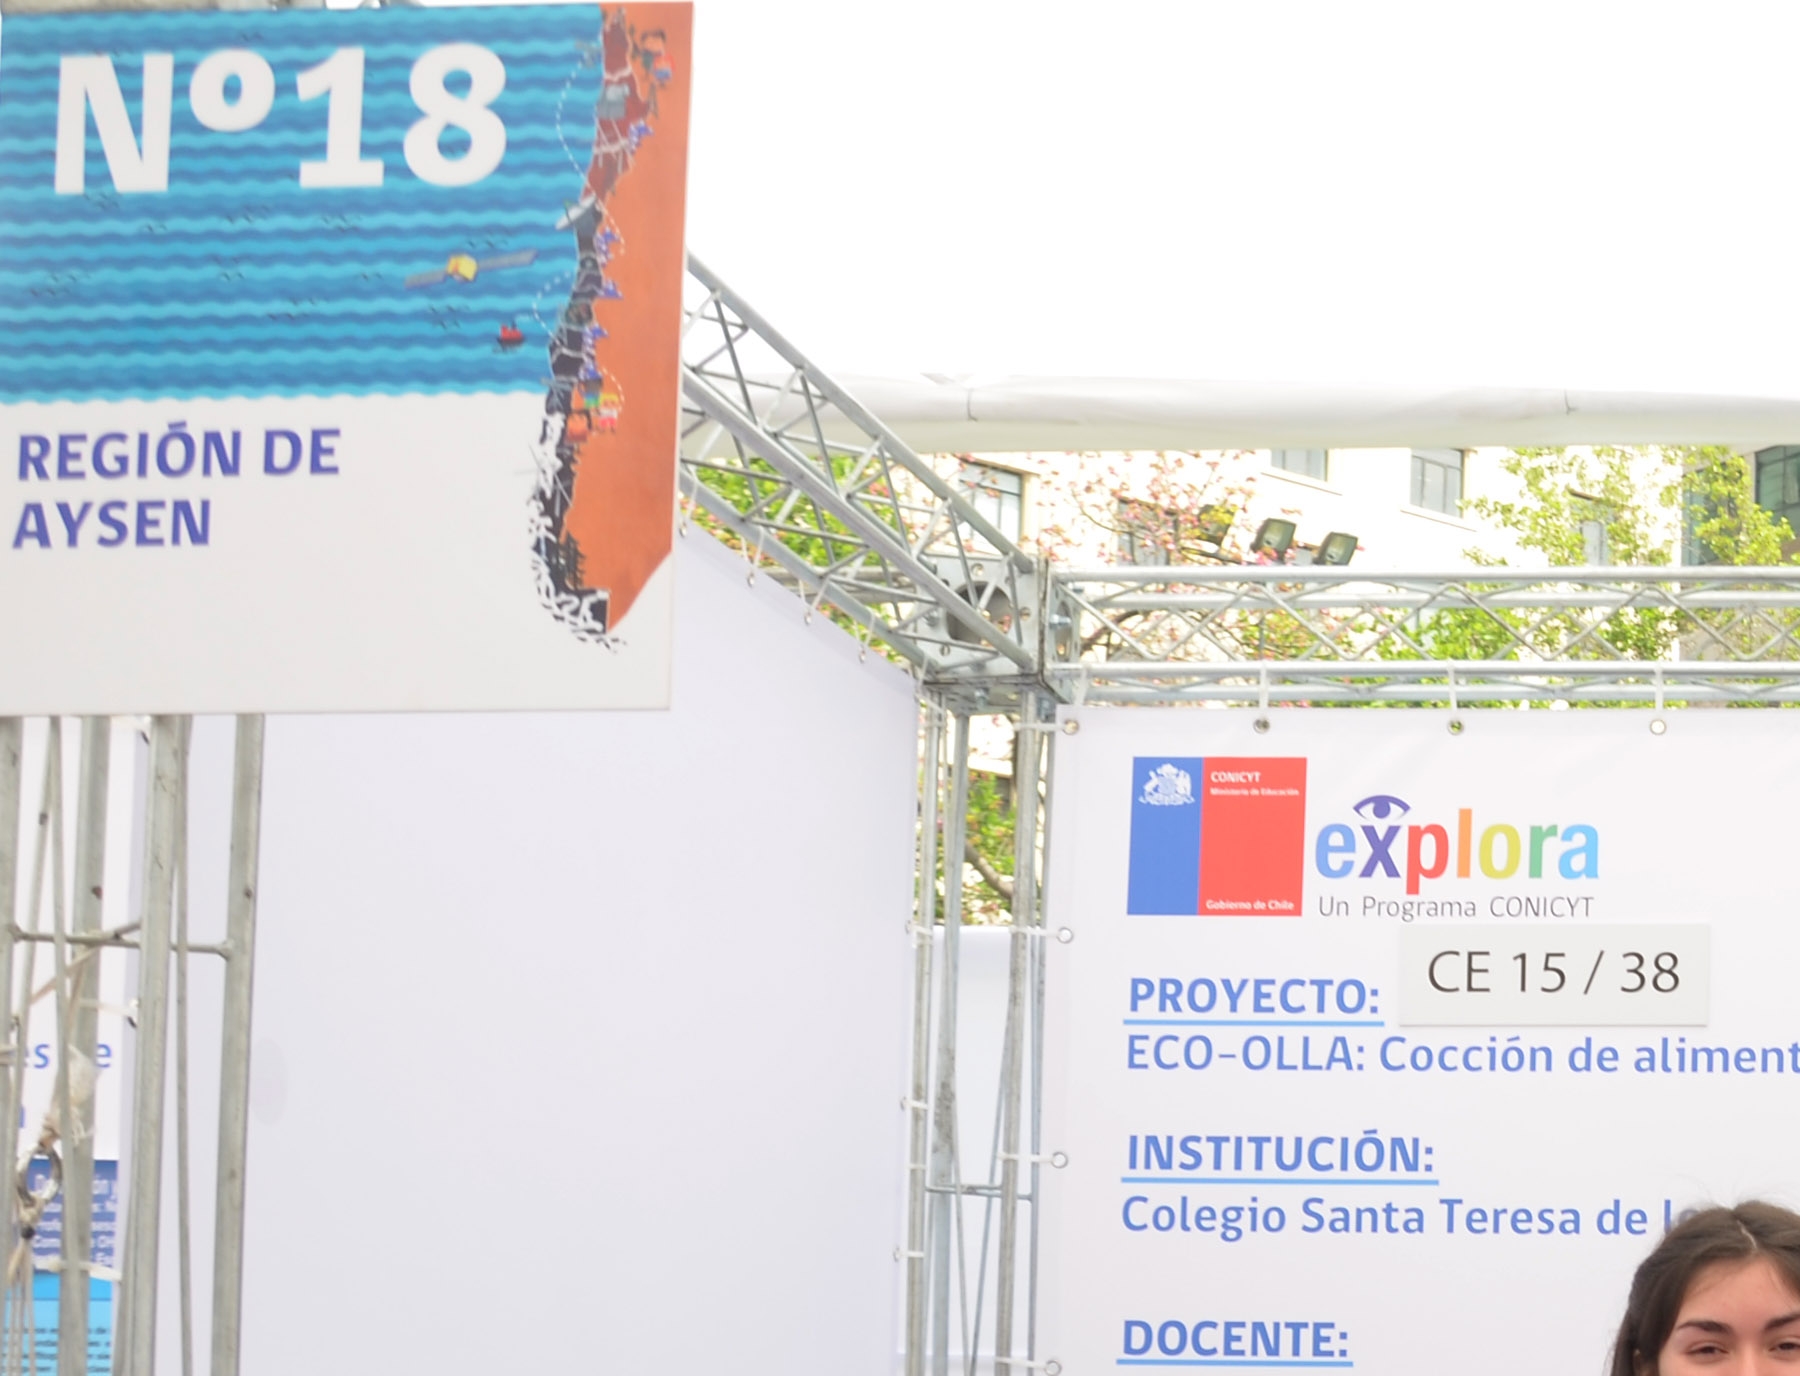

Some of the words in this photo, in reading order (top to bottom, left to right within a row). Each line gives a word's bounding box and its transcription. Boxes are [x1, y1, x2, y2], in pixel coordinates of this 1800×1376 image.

[17, 420, 242, 480] REGIÓN
[262, 428, 342, 476] DE
[12, 499, 211, 549] AYSEN
[1210, 771, 1261, 783] CONICYT
[1210, 787, 1249, 796] Ministerio
[1250, 787, 1260, 796] de
[1261, 786, 1300, 797] Educación
[1315, 808, 1600, 895] explora
[1206, 899, 1251, 911] Gobierno
[1253, 899, 1266, 911] de
[1268, 899, 1295, 911] Chile
[1319, 896, 1350, 918] Un
[1362, 896, 1476, 922] Programa
[1489, 896, 1595, 919] CONICYT
[1428, 949, 1491, 993] CE
[1513, 950, 1567, 993] 15
[1583, 949, 1605, 996] /
[1620, 951, 1681, 993] 38
[1130, 977, 1380, 1015] PROYECTO:
[1380, 1034, 1553, 1074] Cocción
[1568, 1036, 1619, 1074] de
[1128, 1128, 1435, 1173] INSTITUCIÓN:
[1121, 1195, 1287, 1242] Colegio
[1300, 1196, 1425, 1234] Santa
[1439, 1199, 1583, 1235] Teresa
[1596, 1199, 1648, 1236] de
[1122, 1319, 1350, 1359] DOCENTE:
